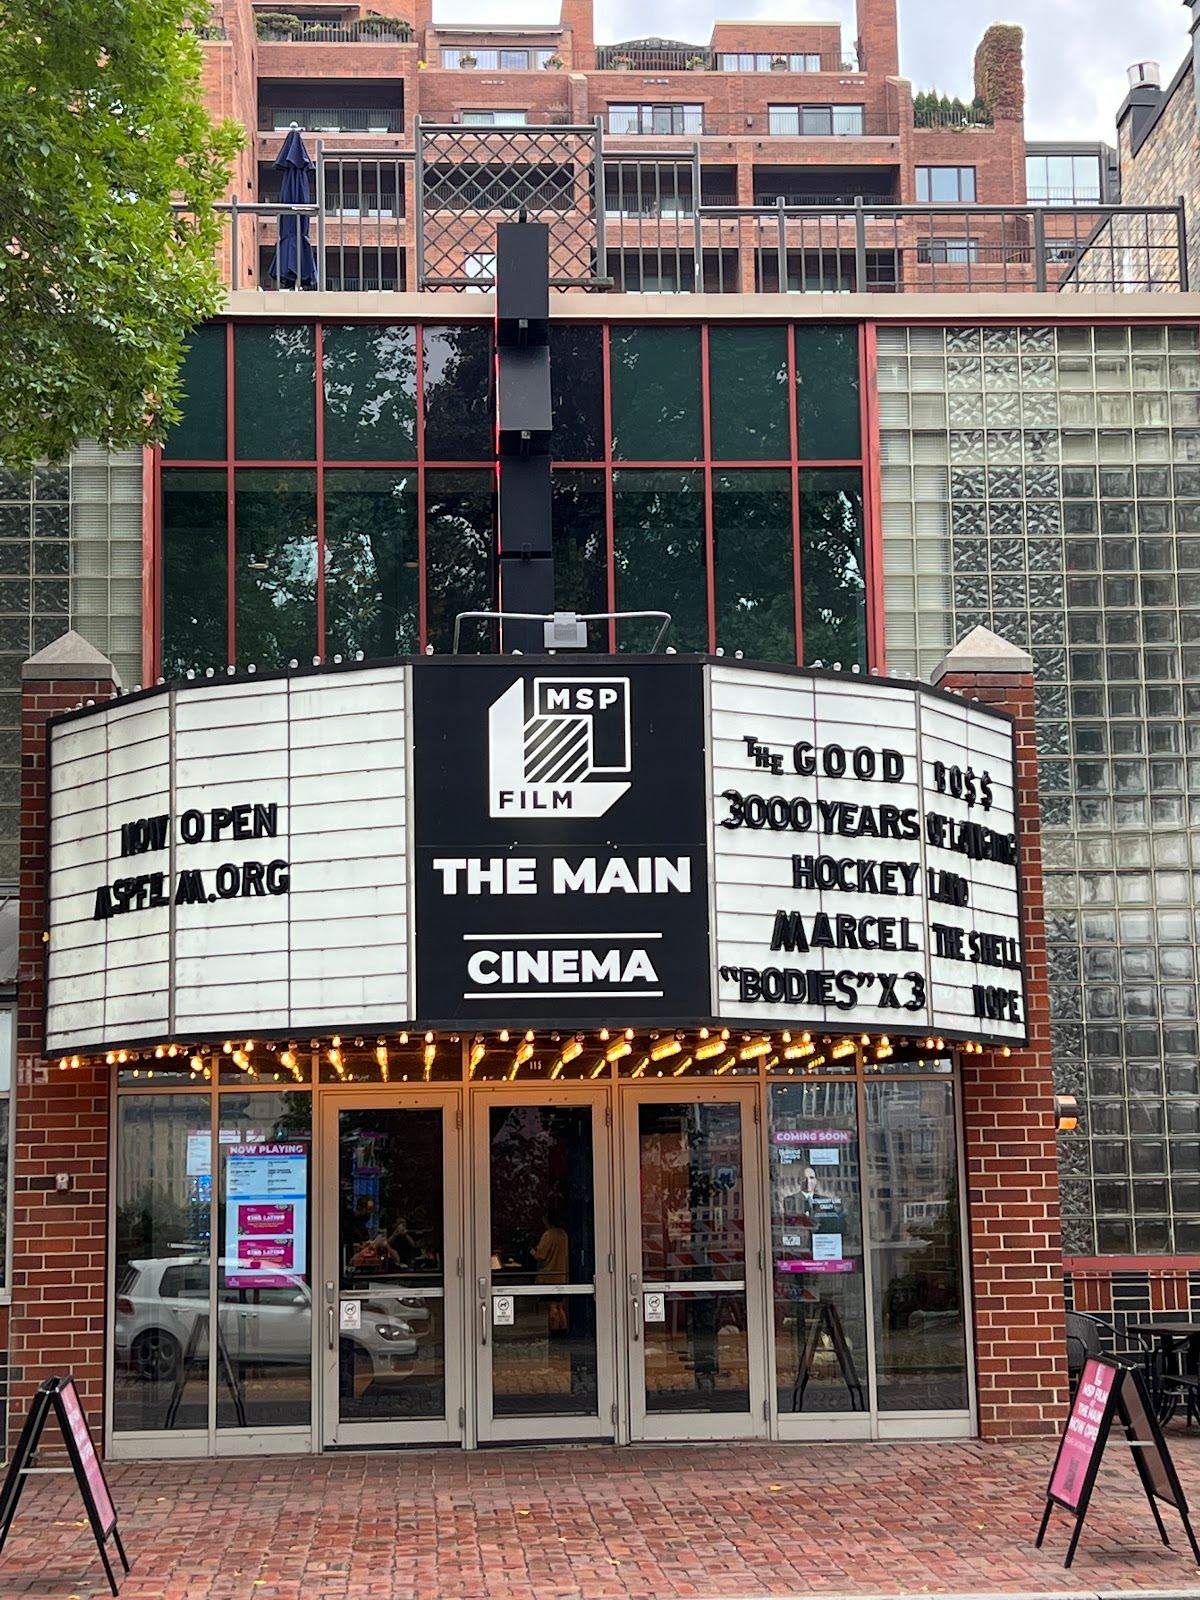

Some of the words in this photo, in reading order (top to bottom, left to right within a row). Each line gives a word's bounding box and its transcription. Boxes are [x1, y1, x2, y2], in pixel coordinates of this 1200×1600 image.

[546, 688, 618, 710] MSP
[743, 735, 784, 775] THE
[793, 741, 905, 783] GOOD
[498, 790, 573, 810] FILM
[719, 789, 812, 832] 3000
[817, 800, 920, 841] YEARS
[926, 811, 947, 849] OF
[120, 814, 170, 857] NOW
[180, 803, 278, 844] OPEN
[432, 858, 537, 895] THE
[553, 856, 691, 894] MAIN
[792, 854, 920, 896] HOCKEY
[927, 867, 969, 907] LAND
[770, 909, 919, 953] MARCEL
[932, 922, 965, 962] THE
[968, 930, 1023, 971] SHELL
[467, 950, 659, 985] CINEMA
[972, 984, 1021, 1023] NOPE
[229, 1146, 257, 1154] NOW
[259, 1145, 304, 1154] PLAYING
[776, 1132, 817, 1141] COMING
[819, 1132, 848, 1141] SOON
